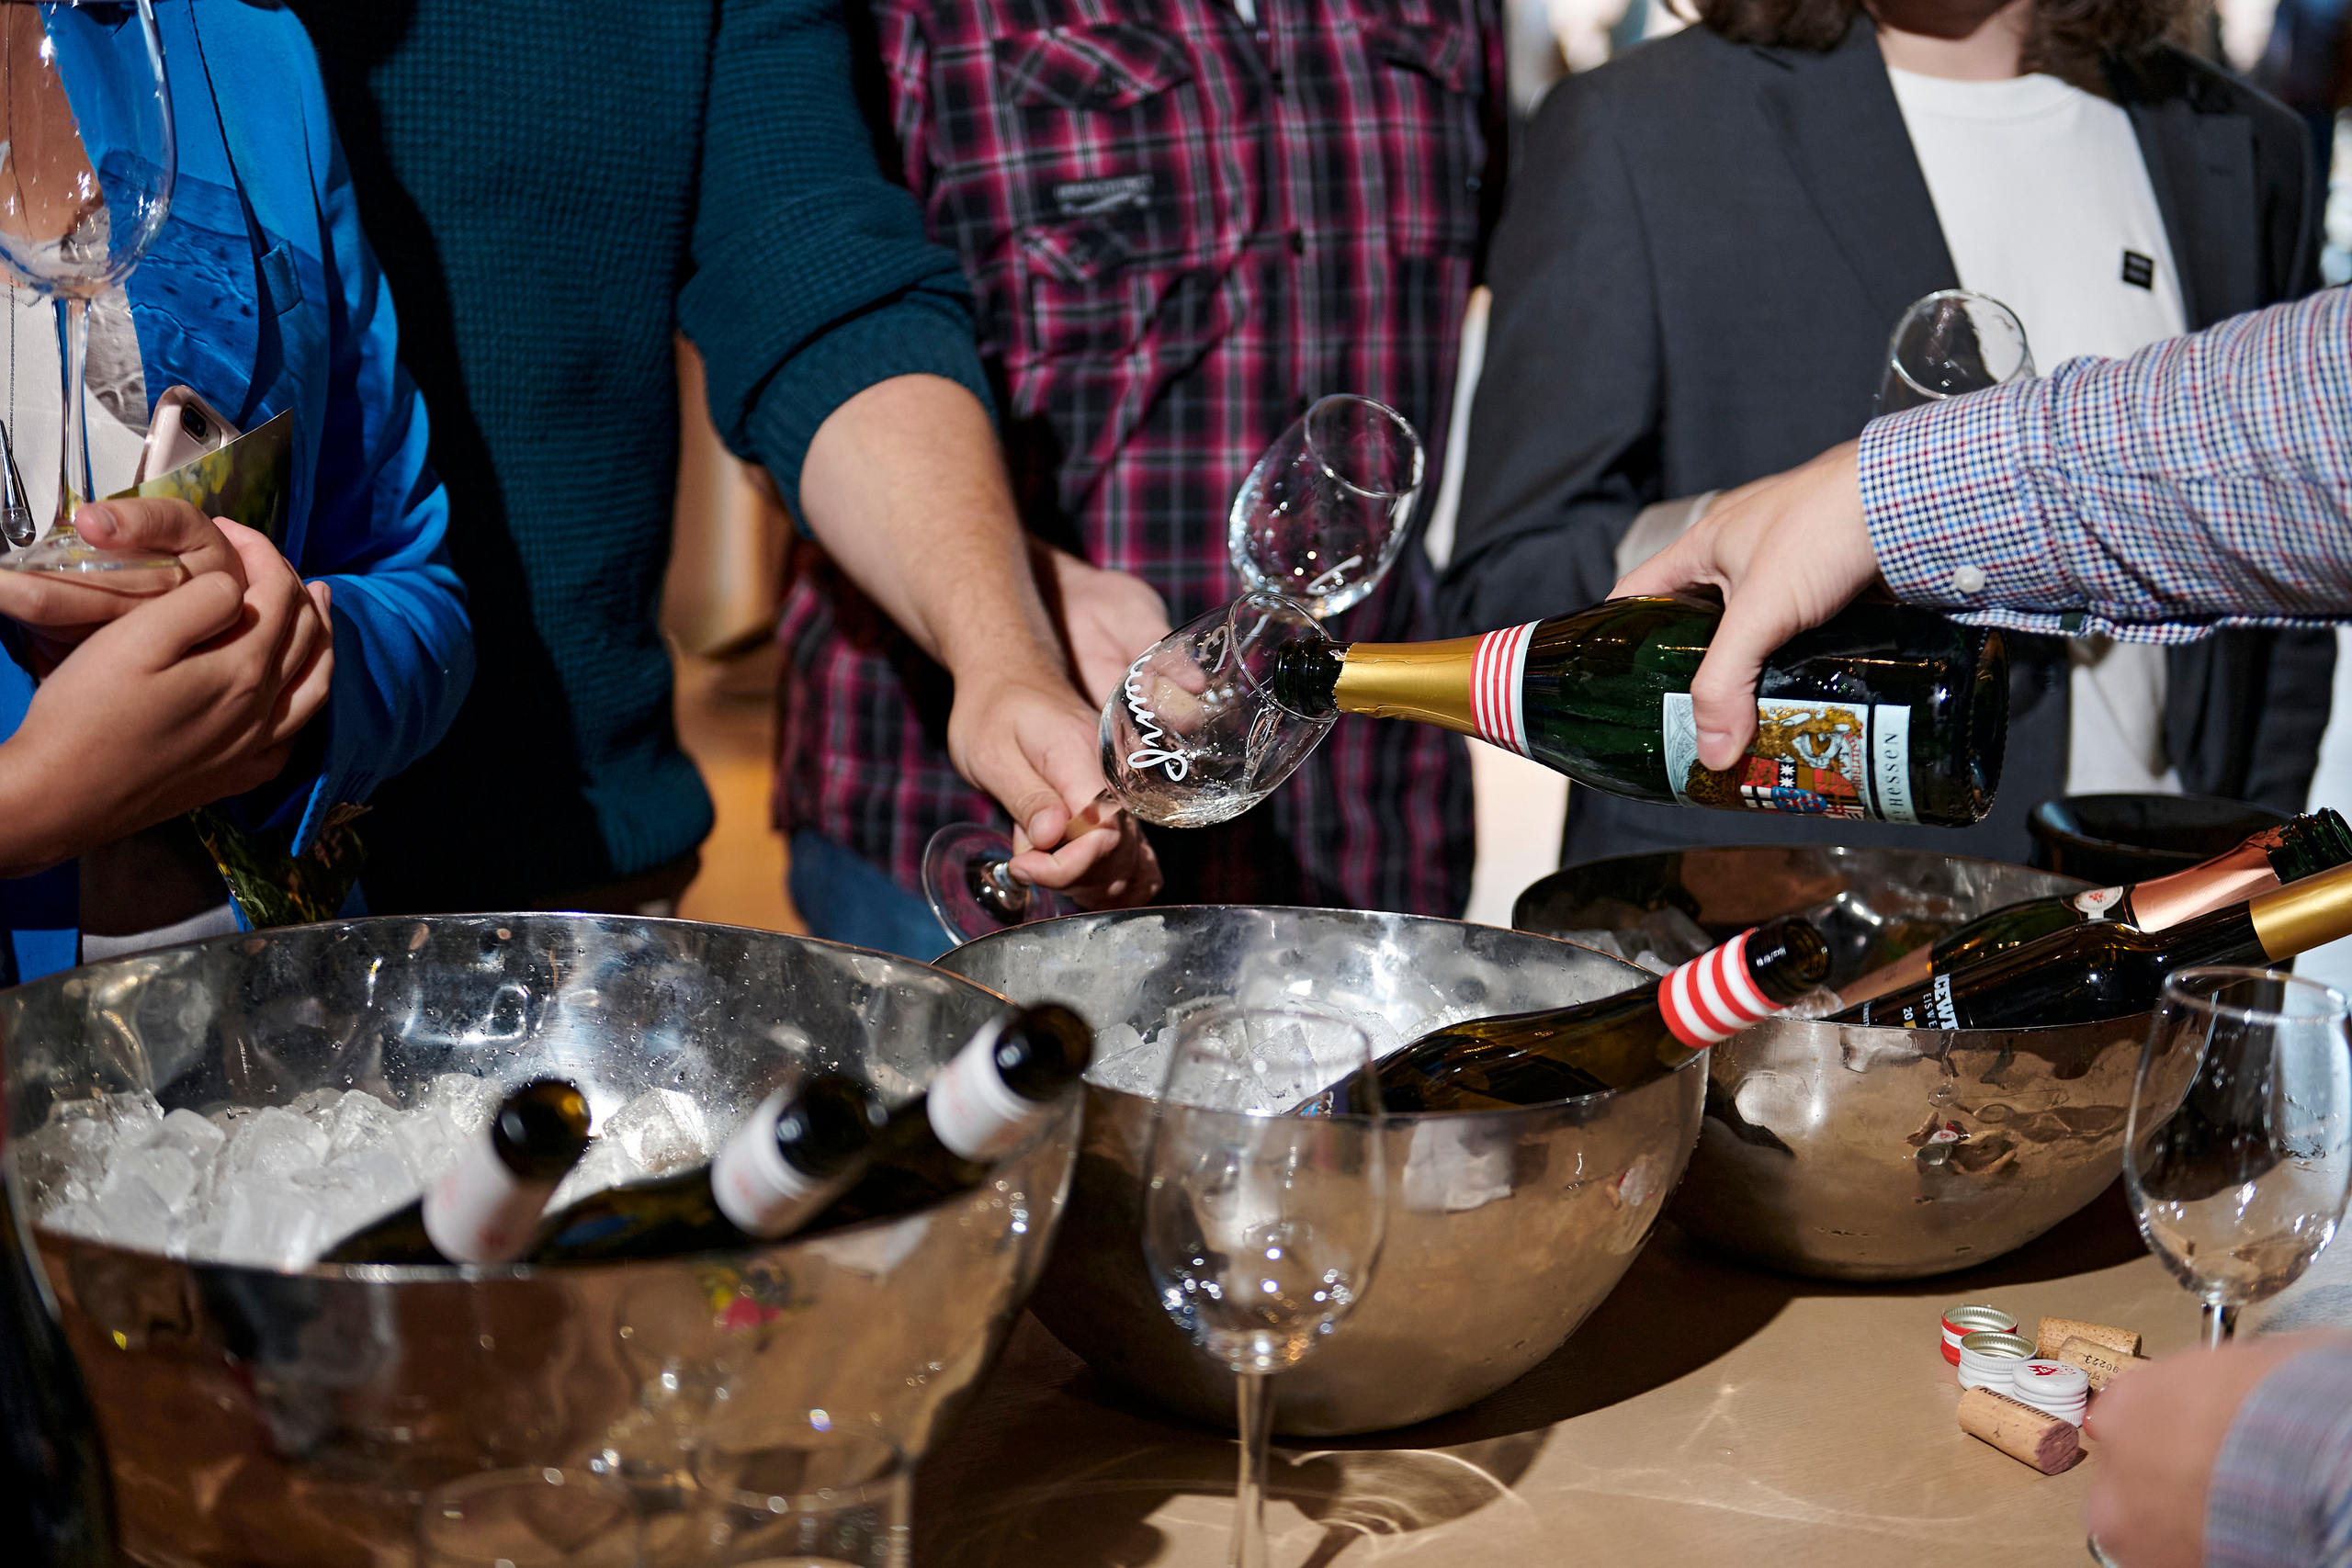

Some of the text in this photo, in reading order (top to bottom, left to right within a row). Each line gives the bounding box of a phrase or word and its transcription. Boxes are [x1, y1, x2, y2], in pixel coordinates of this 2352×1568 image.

[1923, 992, 1939, 1029] EISWE
[1934, 973, 1960, 1030] ICEWI
[2079, 1368, 2101, 1381] PFAL
